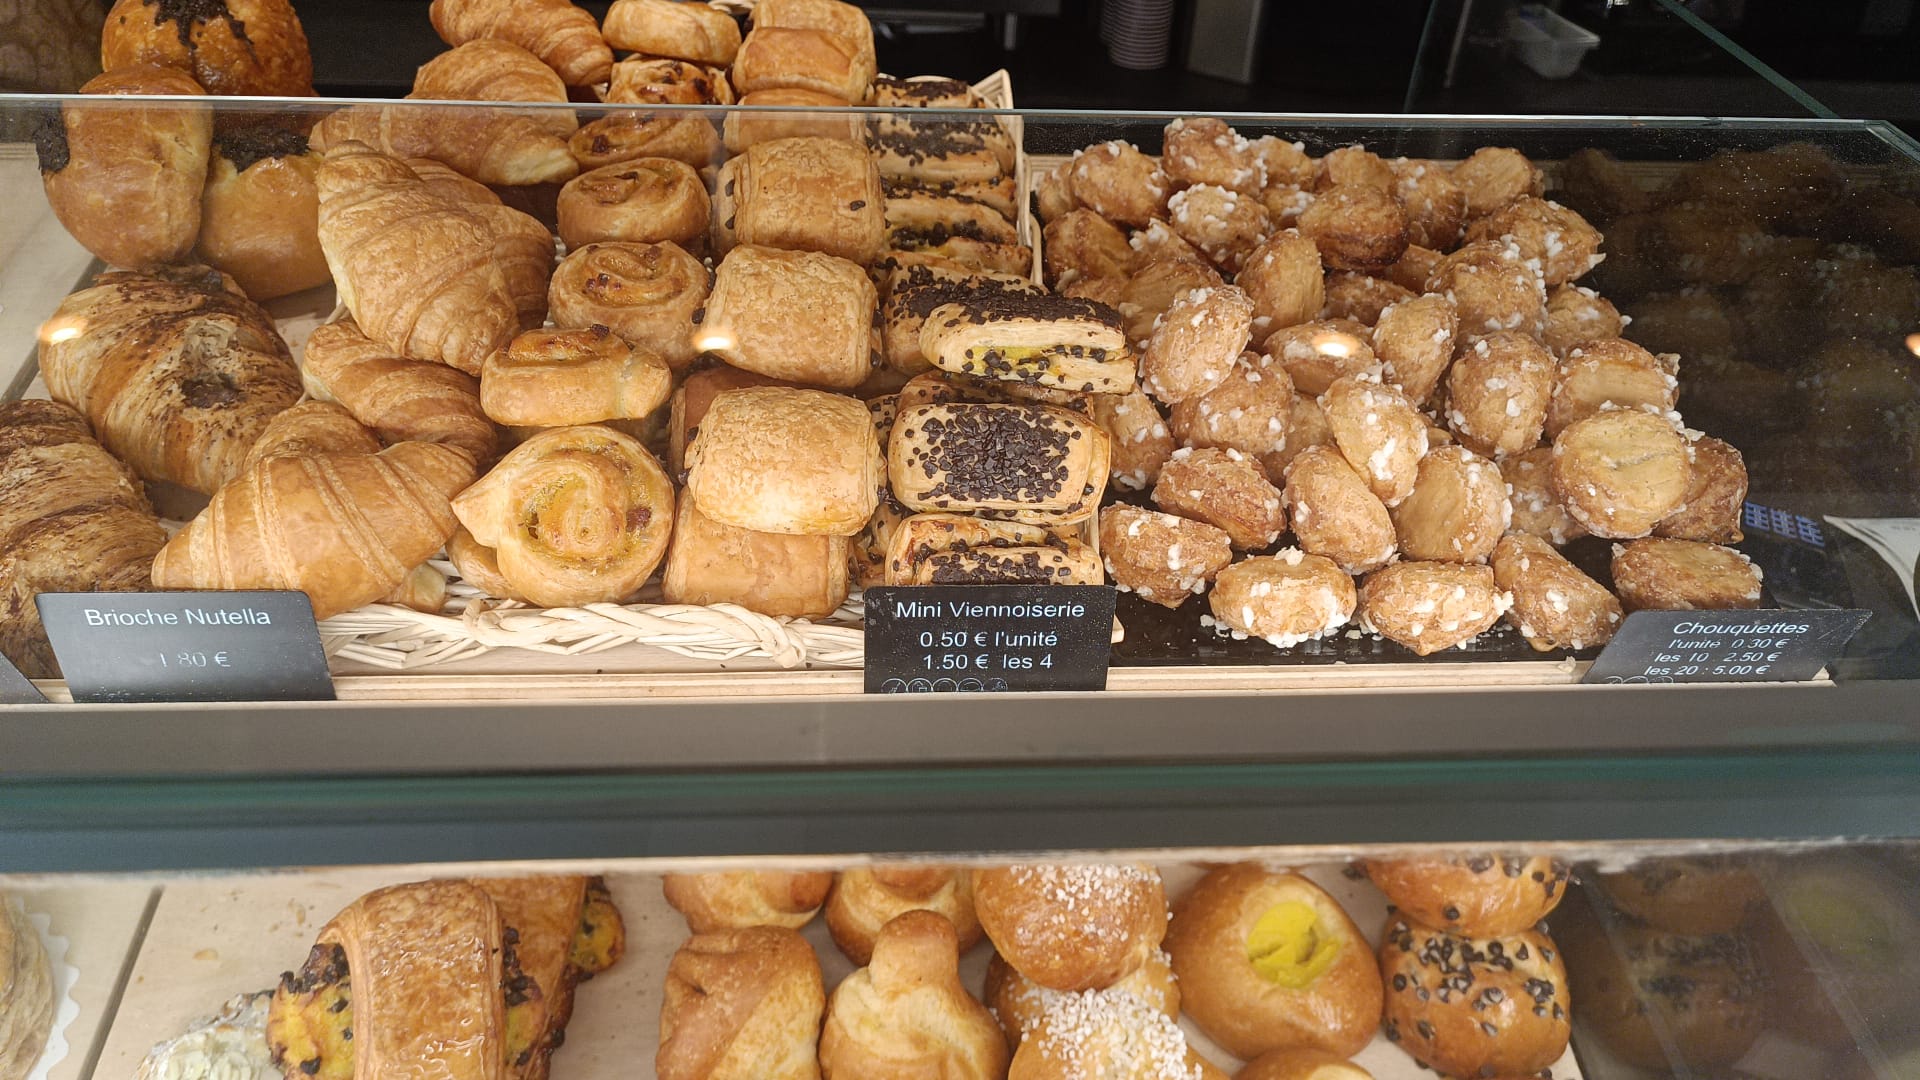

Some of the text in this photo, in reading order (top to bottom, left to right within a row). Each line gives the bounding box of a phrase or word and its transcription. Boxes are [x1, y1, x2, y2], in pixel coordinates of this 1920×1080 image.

[84, 607, 271, 626] Brioche Nutella
[896, 601, 1085, 618] Mini Viennoiserie
[1673, 622, 1810, 637] Chouquettes
[920, 631, 1058, 648] 0.50 € l'unité
[1731, 638, 1772, 649] 030
[1775, 638, 1790, 649] €
[214, 651, 231, 668] €
[923, 654, 1053, 670] 1.50 € les 4
[1654, 651, 1782, 663] les 10 2.50 €
[1643, 665, 1671, 676] les
[1674, 665, 1699, 676] 20
[1712, 665, 1753, 675] 5.00
[1755, 664, 1771, 675] €
